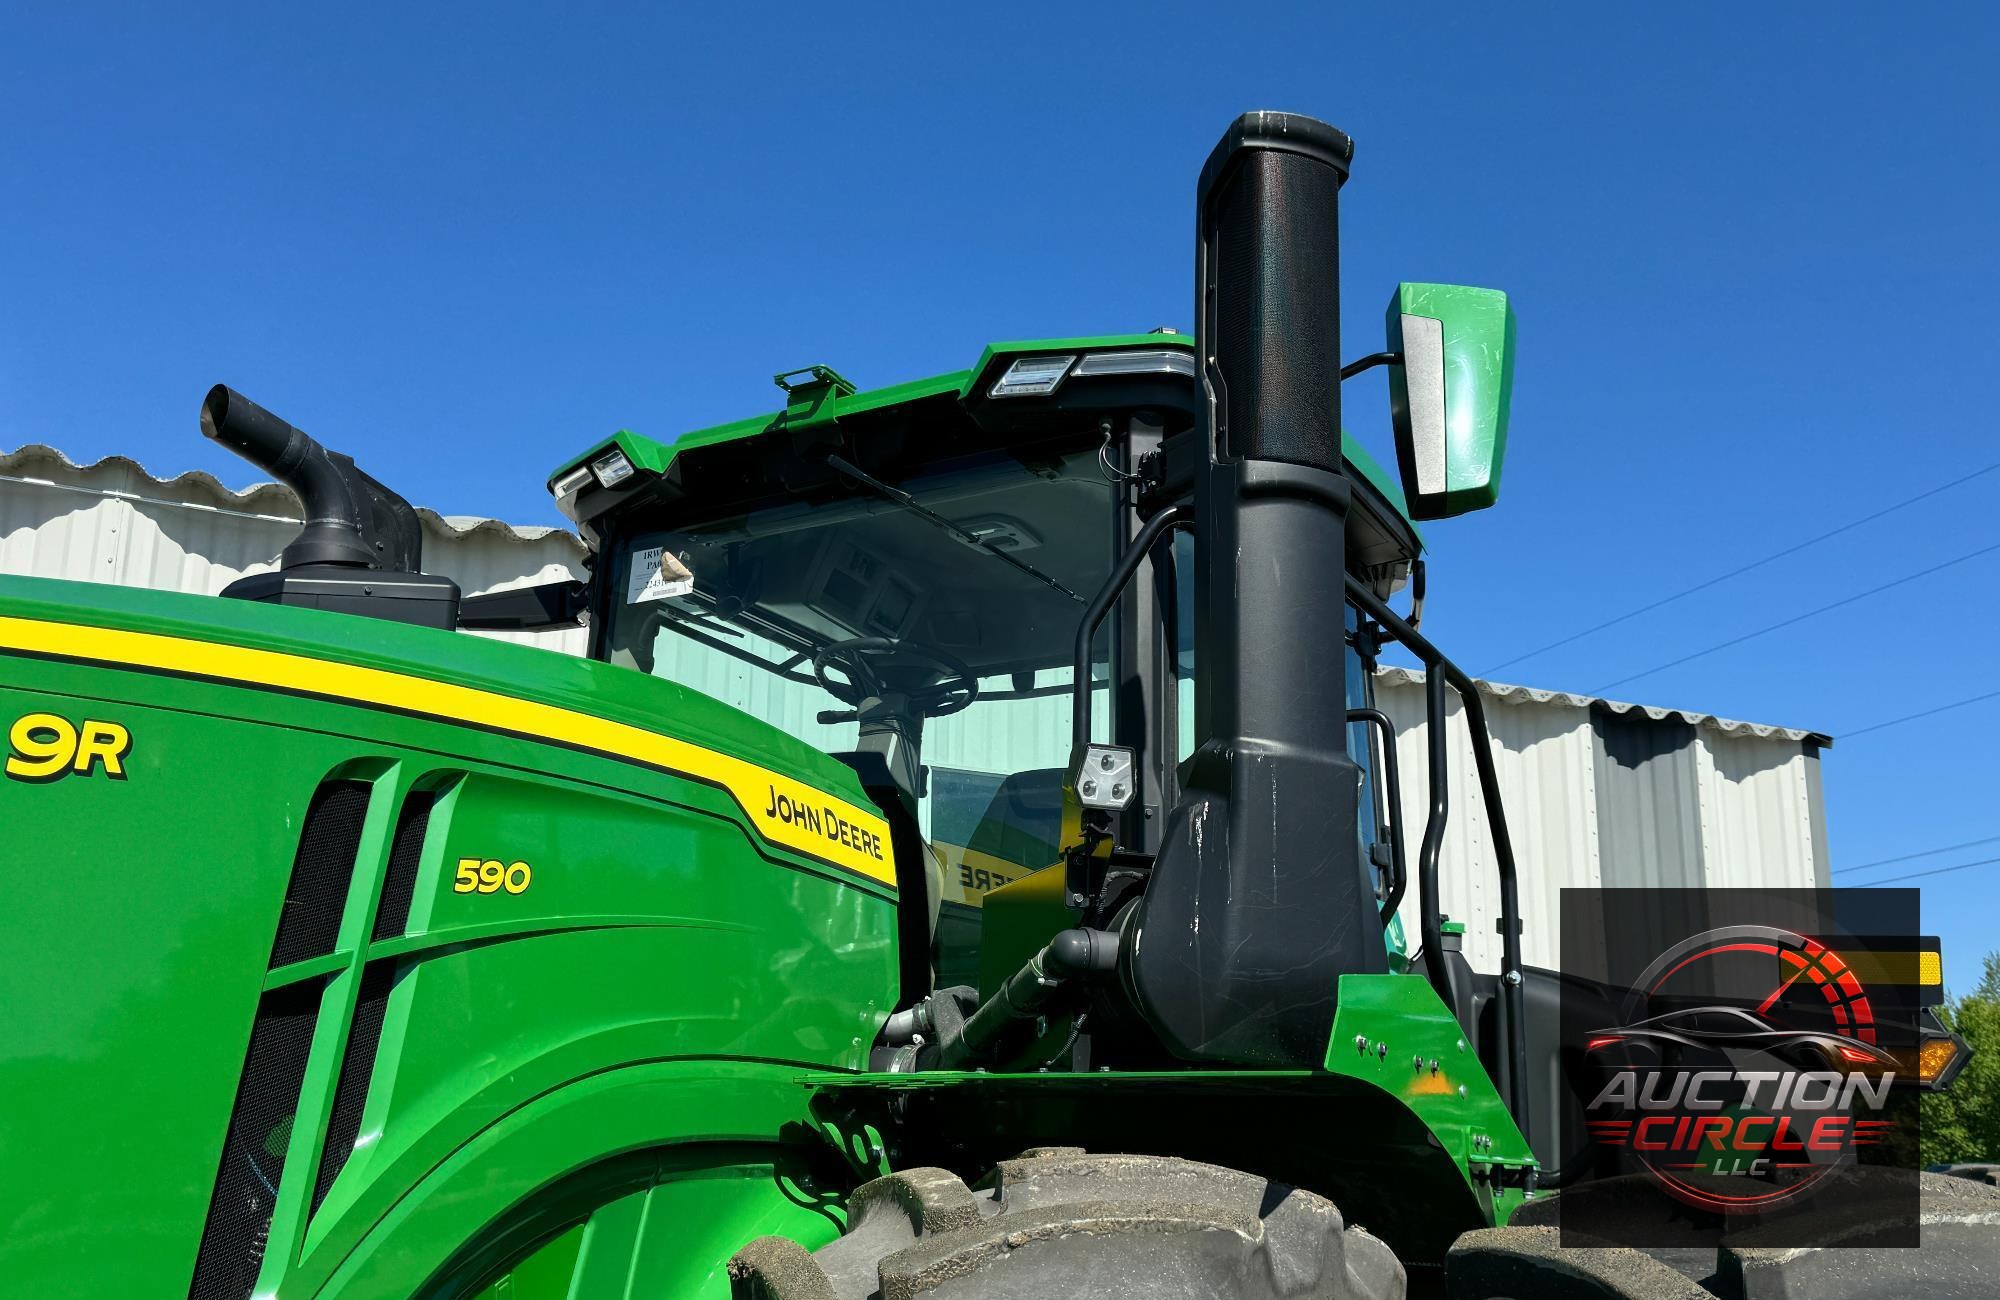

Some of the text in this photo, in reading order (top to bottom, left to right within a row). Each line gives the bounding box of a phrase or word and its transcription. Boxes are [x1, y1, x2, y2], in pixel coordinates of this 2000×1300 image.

[5, 712, 132, 783] 9R
[766, 784, 884, 861] JOHN DEERE
[454, 858, 532, 895] 590
